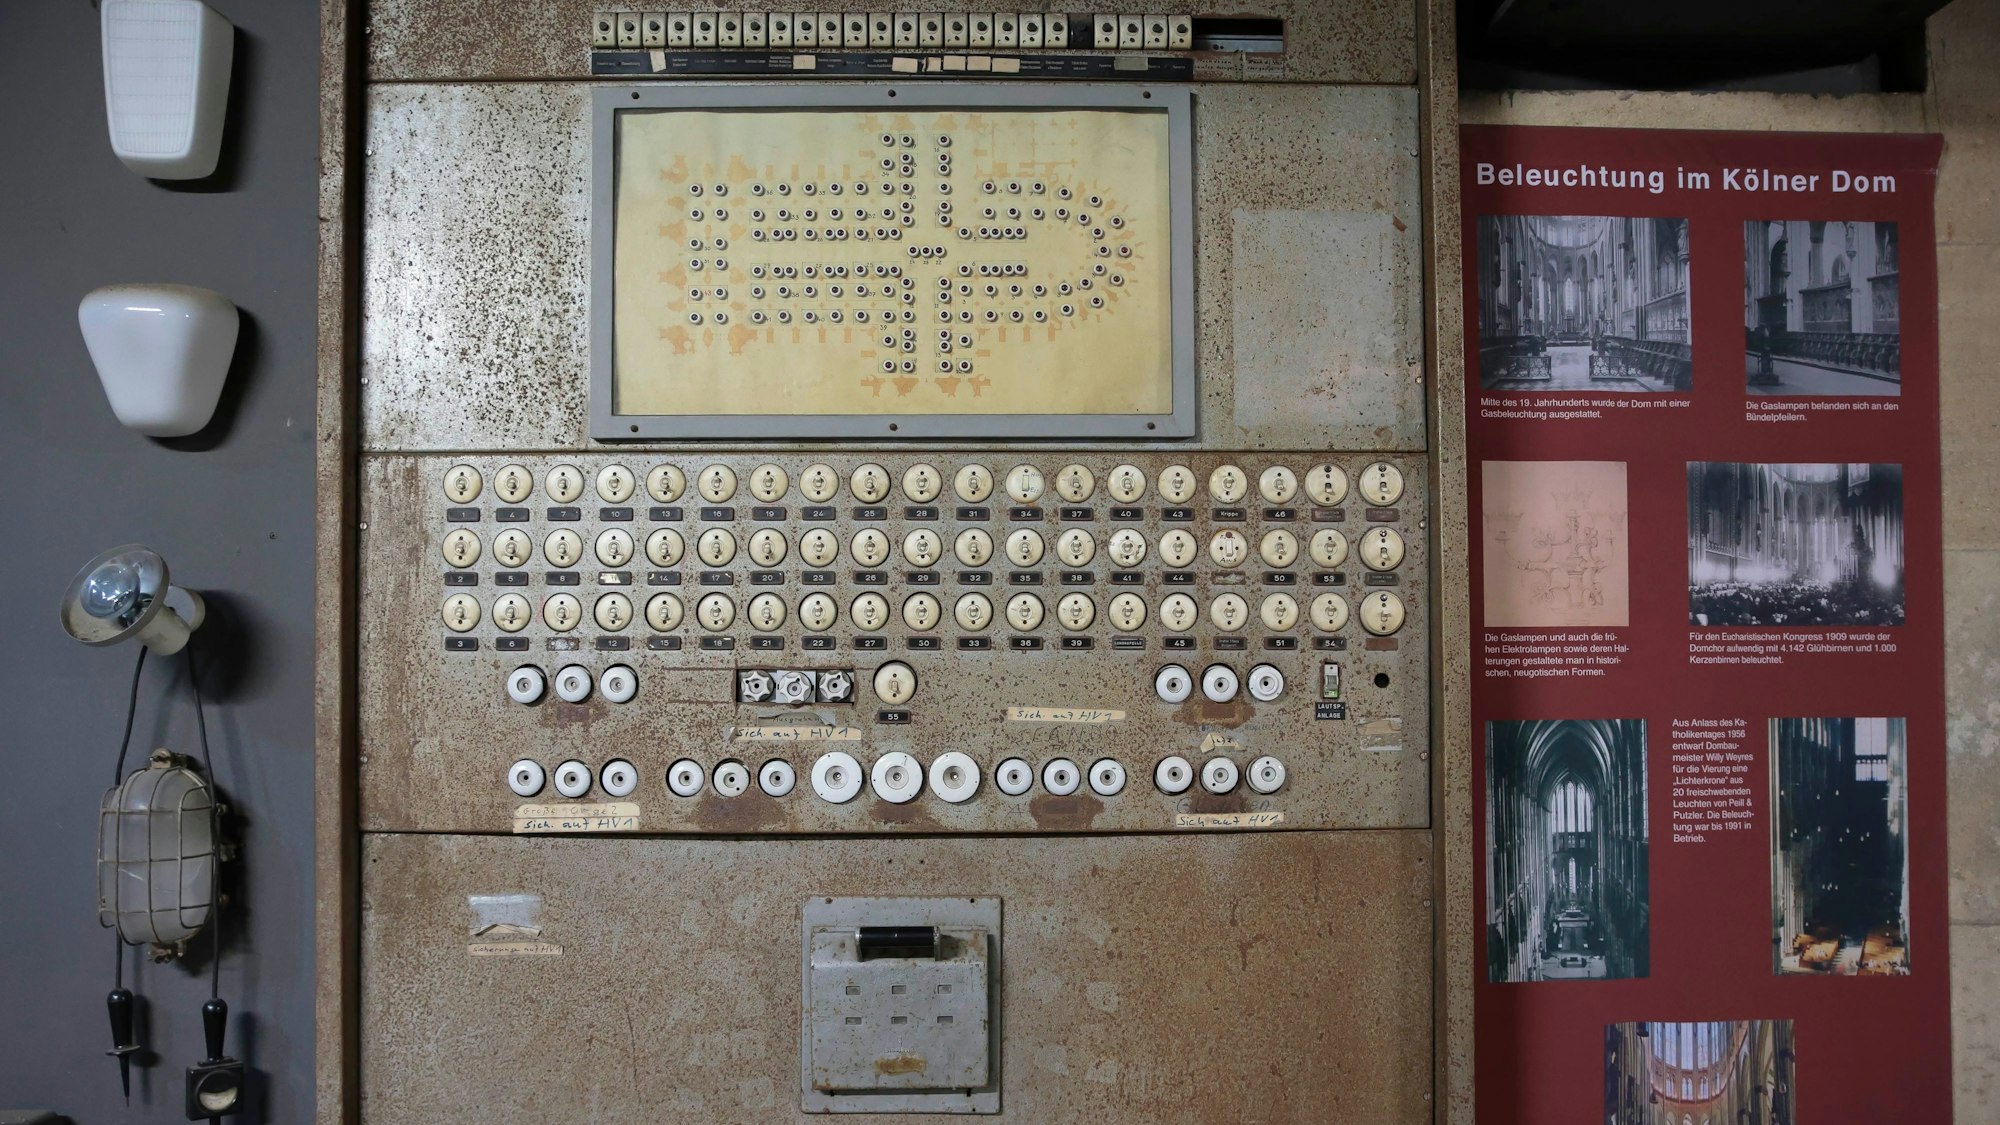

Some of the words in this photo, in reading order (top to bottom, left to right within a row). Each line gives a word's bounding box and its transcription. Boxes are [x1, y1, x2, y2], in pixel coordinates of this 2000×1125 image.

[1478, 164, 1664, 193] Beleuchtung
[1678, 167, 1709, 189] im
[1723, 168, 1819, 191] Kölner
[1833, 171, 1895, 193] Dom
[1481, 398, 1500, 406] Mitte
[1520, 399, 1532, 407] 19.
[1534, 398, 1589, 406] Jahrhunderts
[1592, 399, 1615, 407] wurde
[1632, 400, 1651, 408] Dom
[1669, 399, 1690, 407] einer
[1746, 401, 1759, 409] Die
[1761, 402, 1809, 411] Gaslampen
[1883, 402, 1898, 410] den
[1481, 409, 1547, 420] Gasbeleuchtung
[1549, 410, 1602, 420] ausgestattet.
[1746, 413, 1807, 423] Bündelpfeilern.
[1501, 634, 1547, 643] Gaslampen
[1550, 633, 1565, 641] und
[1568, 633, 1589, 641] auch
[1591, 633, 1603, 641] die
[1605, 633, 1617, 641] frü-
[1690, 632, 1703, 640] Für
[1722, 632, 1781, 641] Eucharistischen
[1783, 633, 1823, 642] Kongress
[1485, 645, 1500, 653] hen
[1503, 645, 1561, 655] Elektrolampen
[1690, 644, 1725, 652] Domchor
[1727, 644, 1764, 654] aufwendig
[1766, 644, 1778, 652] mit
[1781, 644, 1804, 652] 4.142
[1807, 644, 1853, 652] Glühbirnen
[1856, 644, 1872, 652] und
[1875, 644, 1896, 652] 1.000
[1485, 658, 1520, 667] terungen
[1523, 657, 1563, 666] gestaltete
[1587, 656, 1594, 664] in
[1596, 656, 1621, 664] histori-
[1690, 656, 1740, 664] Kerzenbirnen
[1742, 656, 1783, 664] beleuchtet.
[1485, 669, 1511, 677] schen,
[1514, 668, 1569, 678] neugotischen
[1572, 668, 1605, 676] Formen.
[1672, 719, 1689, 727] Aus
[1691, 719, 1718, 727] Anlass
[1735, 718, 1747, 726] Ka-
[1672, 730, 1725, 740] tholikentages
[1728, 730, 1745, 738] 1956
[1672, 742, 1703, 750] entwarf
[1706, 742, 1739, 750] Dombau-
[1706, 753, 1724, 763] Willy
[1726, 753, 1753, 762] Weyres
[1673, 765, 1684, 773] für
[1687, 765, 1699, 773] die
[1702, 765, 1730, 774] Vierung
[1732, 764, 1748, 772] eine
[1673, 776, 1728, 785] „Lichterkrone“
[1673, 788, 1684, 796] 20
[1686, 787, 1751, 796] freischwebenden
[1673, 800, 1711, 808] Leuchten
[1729, 799, 1744, 807] Peill
[1746, 798, 1752, 806] &
[1674, 811, 1704, 819] Putzler.
[1707, 811, 1720, 819] Die
[1722, 810, 1754, 818] Beleuch-
[1673, 823, 1692, 832] tung
[1711, 822, 1722, 830] bis
[1725, 822, 1741, 830] 1991
[1674, 834, 1705, 842] Betrieb.
